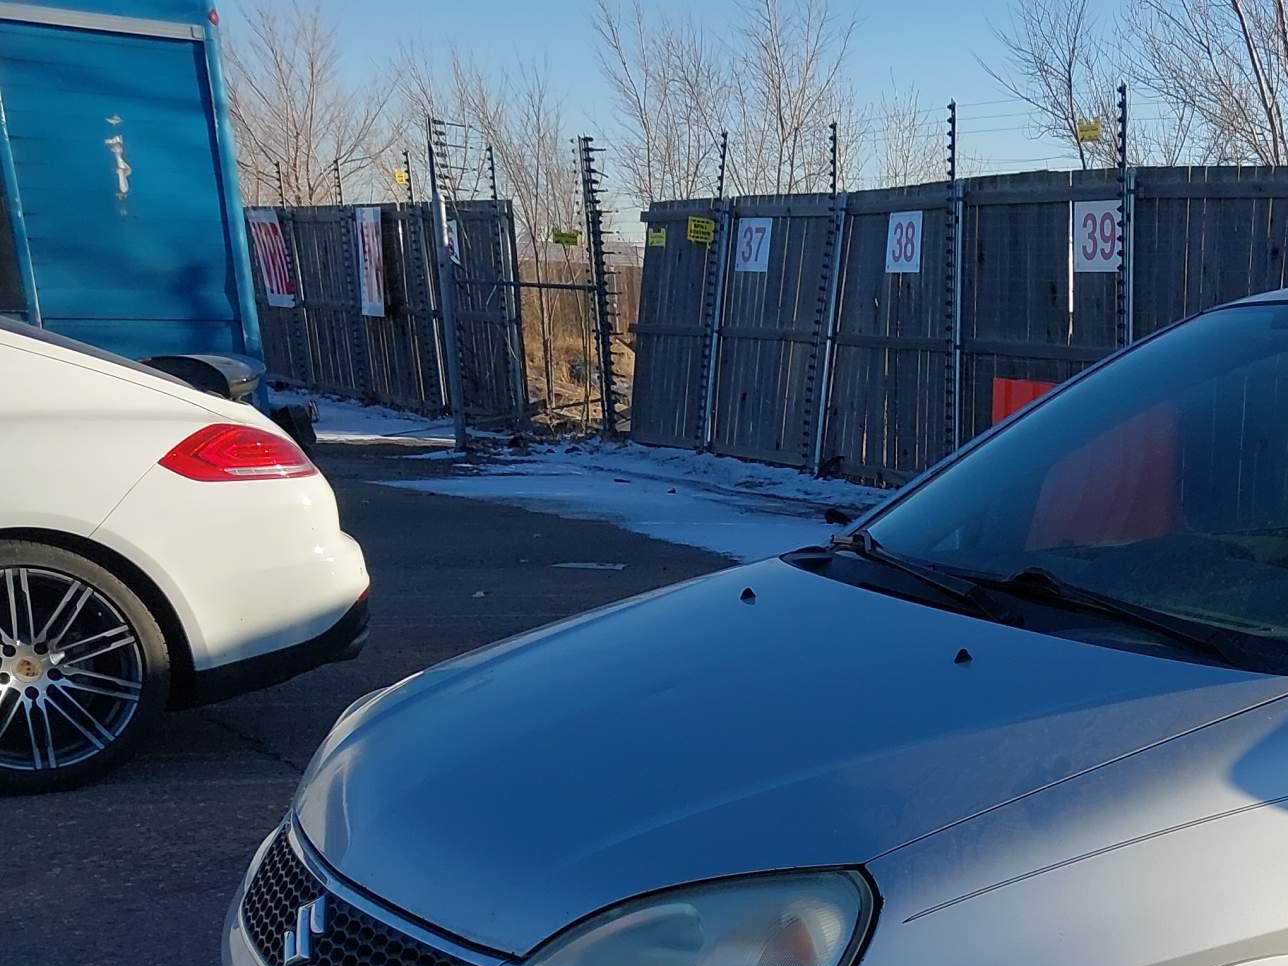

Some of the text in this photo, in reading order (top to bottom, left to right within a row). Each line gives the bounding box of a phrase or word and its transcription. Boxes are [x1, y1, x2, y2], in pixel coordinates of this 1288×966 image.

[741, 226, 766, 263] 37
[892, 221, 915, 263] 38
[1082, 211, 1116, 261] 39
